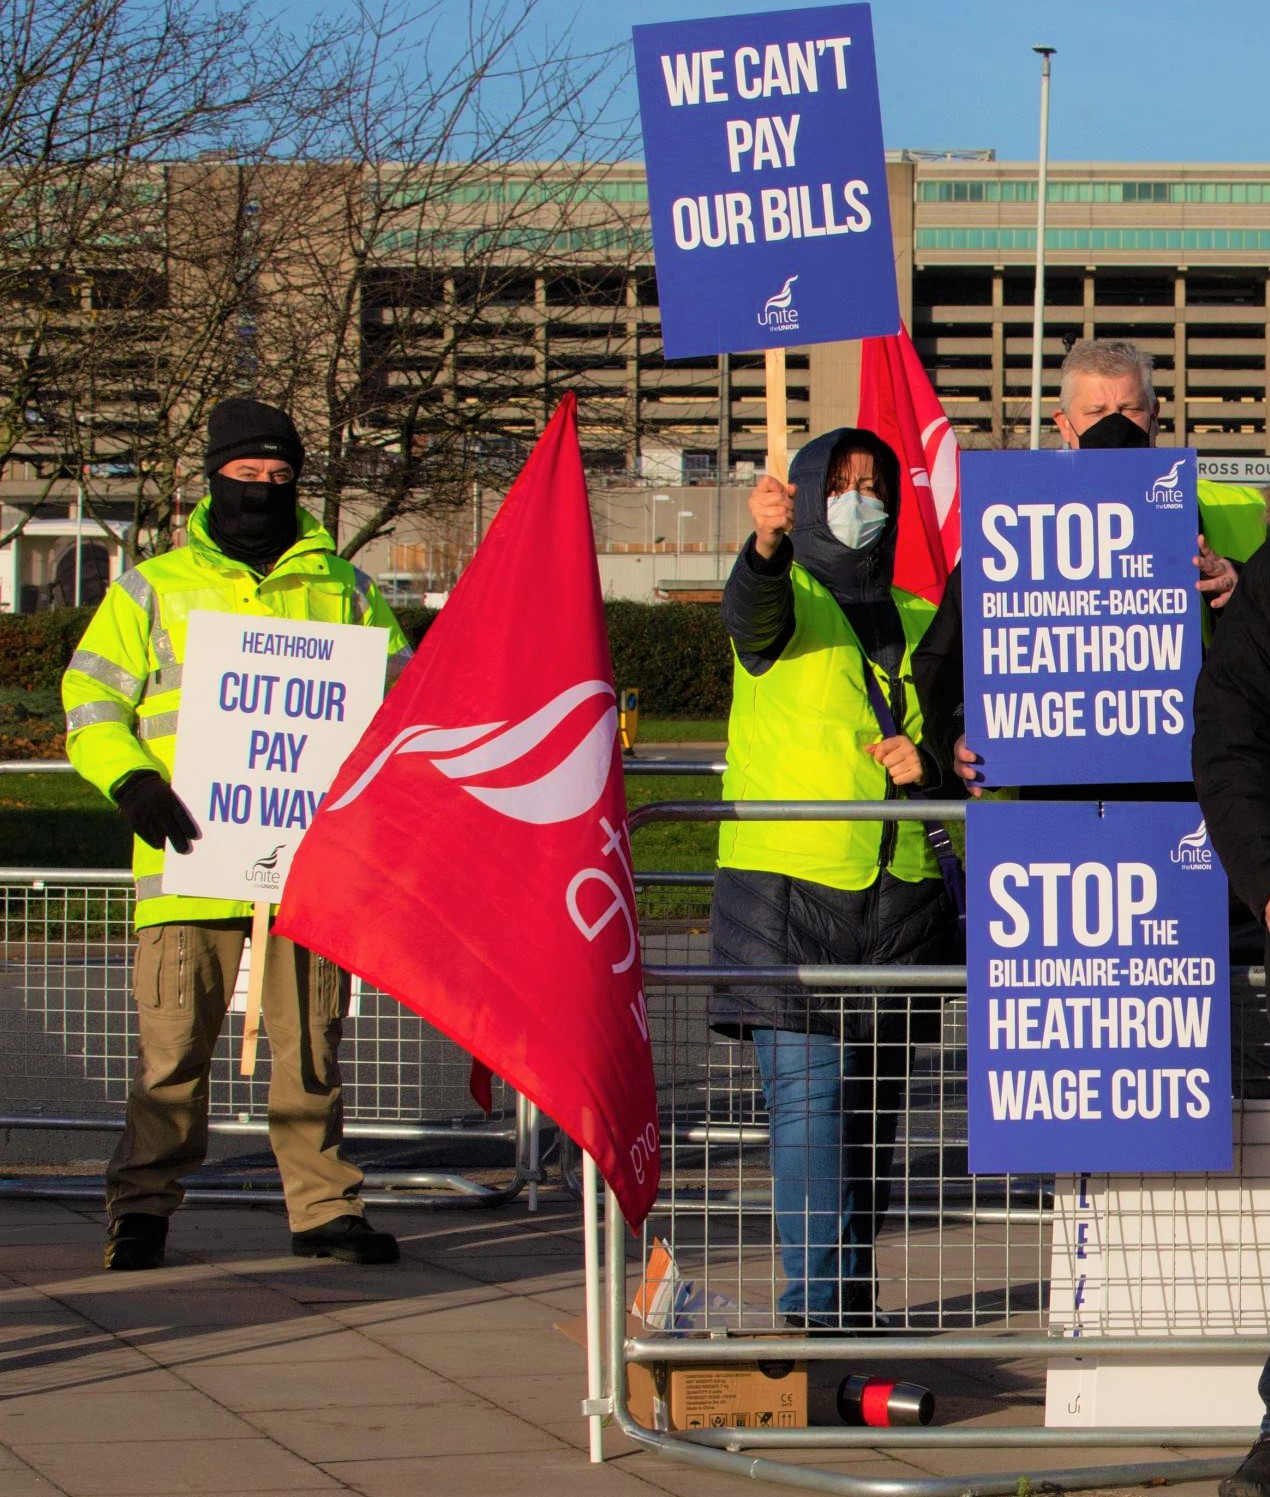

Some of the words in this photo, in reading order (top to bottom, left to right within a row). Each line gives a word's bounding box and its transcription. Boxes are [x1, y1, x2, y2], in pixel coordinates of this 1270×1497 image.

[661, 50, 728, 107] WE
[734, 37, 852, 99] CAN'T
[726, 114, 801, 172] PAY
[672, 192, 756, 251] OUR
[761, 180, 872, 241] BILLS
[757, 308, 799, 325] unite
[1199, 463, 1239, 475] ROSS
[1145, 487, 1184, 503] unite
[981, 503, 1135, 582] STOP
[1119, 554, 1153, 578] THE
[983, 588, 1188, 618] BILLIONAIRE-BACKED
[242, 631, 334, 661] HEATHROW
[983, 624, 1184, 675] HEATHROW
[219, 671, 280, 715] CUT
[284, 677, 347, 722] OUR
[983, 691, 1086, 739] WAGE
[1094, 689, 1184, 737] CUTS
[248, 730, 308, 773] PAY
[209, 782, 252, 824] NO
[245, 869, 280, 884] unite
[1169, 848, 1212, 863] unite
[989, 862, 1158, 947] STOP
[1140, 920, 1179, 946] THE
[989, 957, 1216, 988] BILLIONAIRE-BACKED
[989, 997, 1212, 1050] HEATHROW
[988, 1069, 1102, 1121] WAGE
[1111, 1068, 1210, 1119] CUTS
